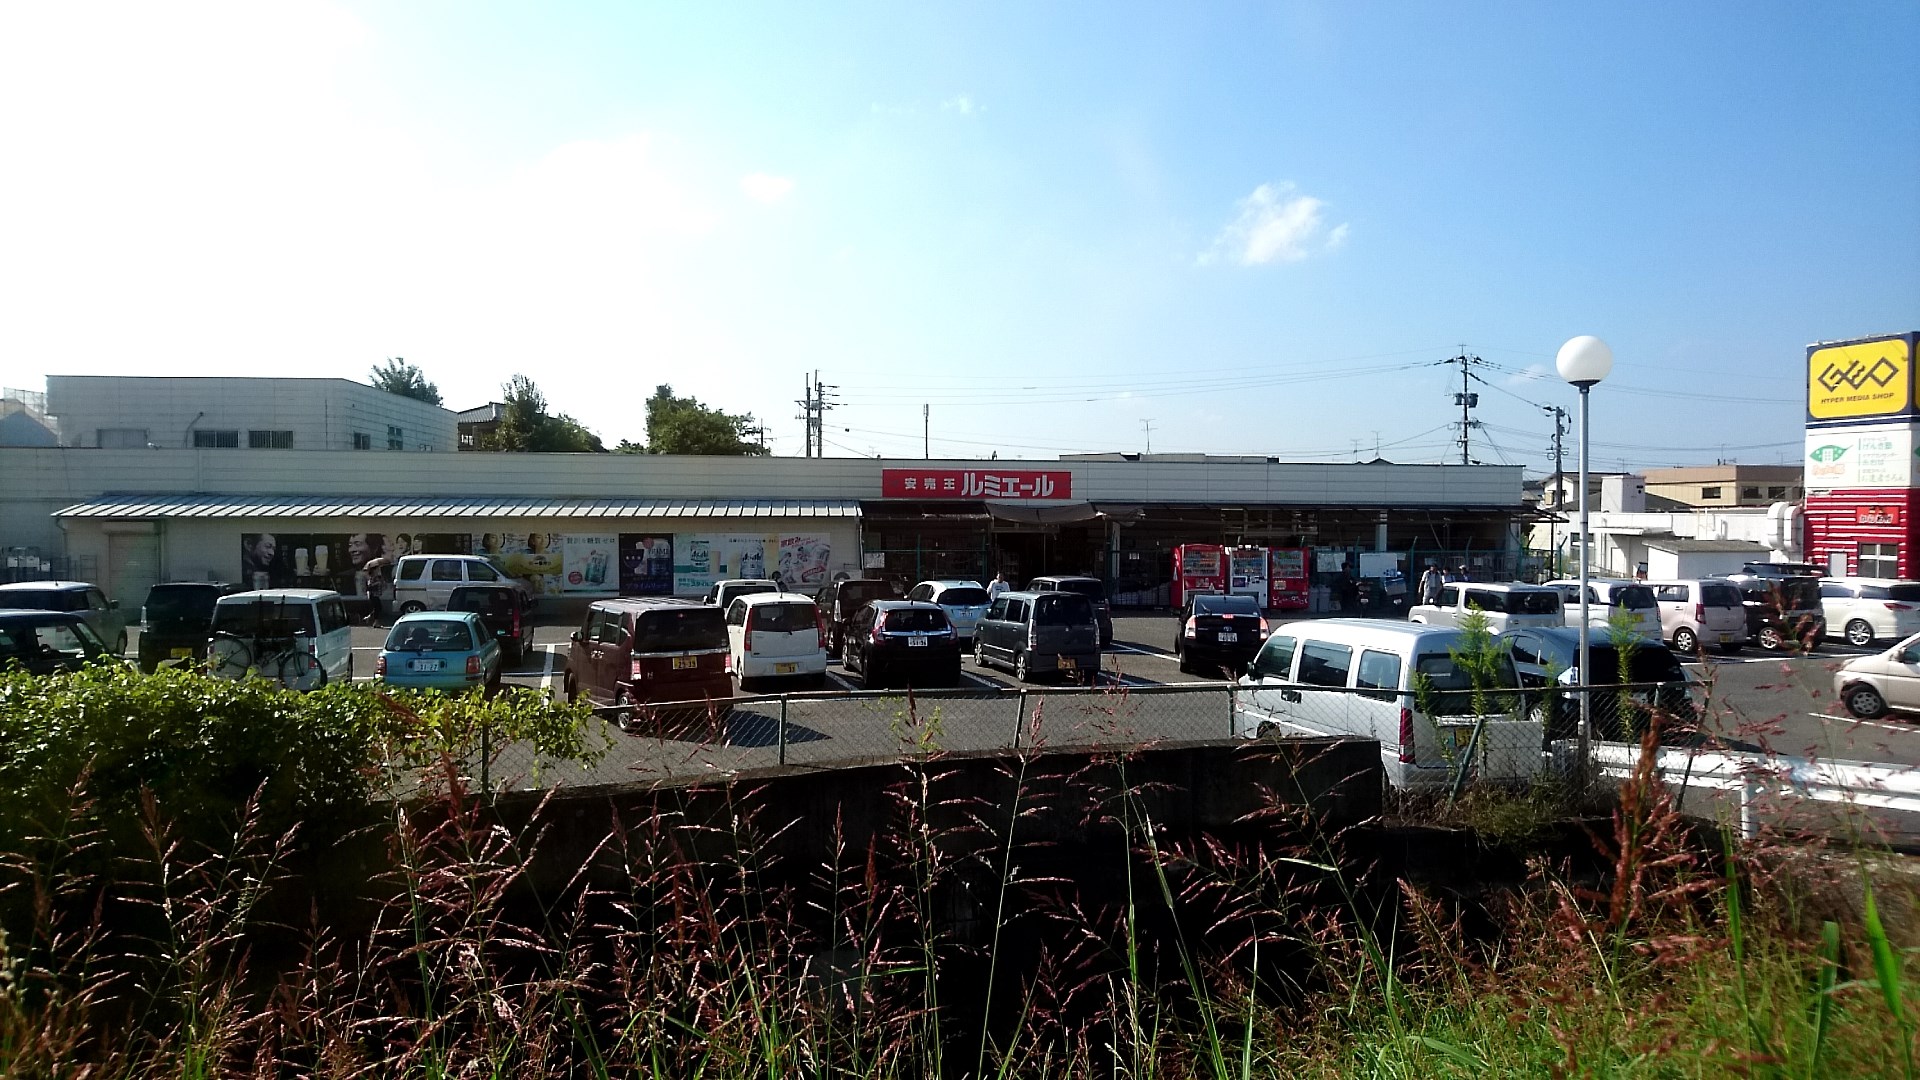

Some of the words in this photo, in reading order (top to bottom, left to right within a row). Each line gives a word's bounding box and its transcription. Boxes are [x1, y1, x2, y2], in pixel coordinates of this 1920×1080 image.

[1817, 356, 1899, 393] GEO
[1872, 392, 1895, 400] SHOP
[904, 477, 956, 491] 安売王
[961, 472, 1055, 497] ルミエール
